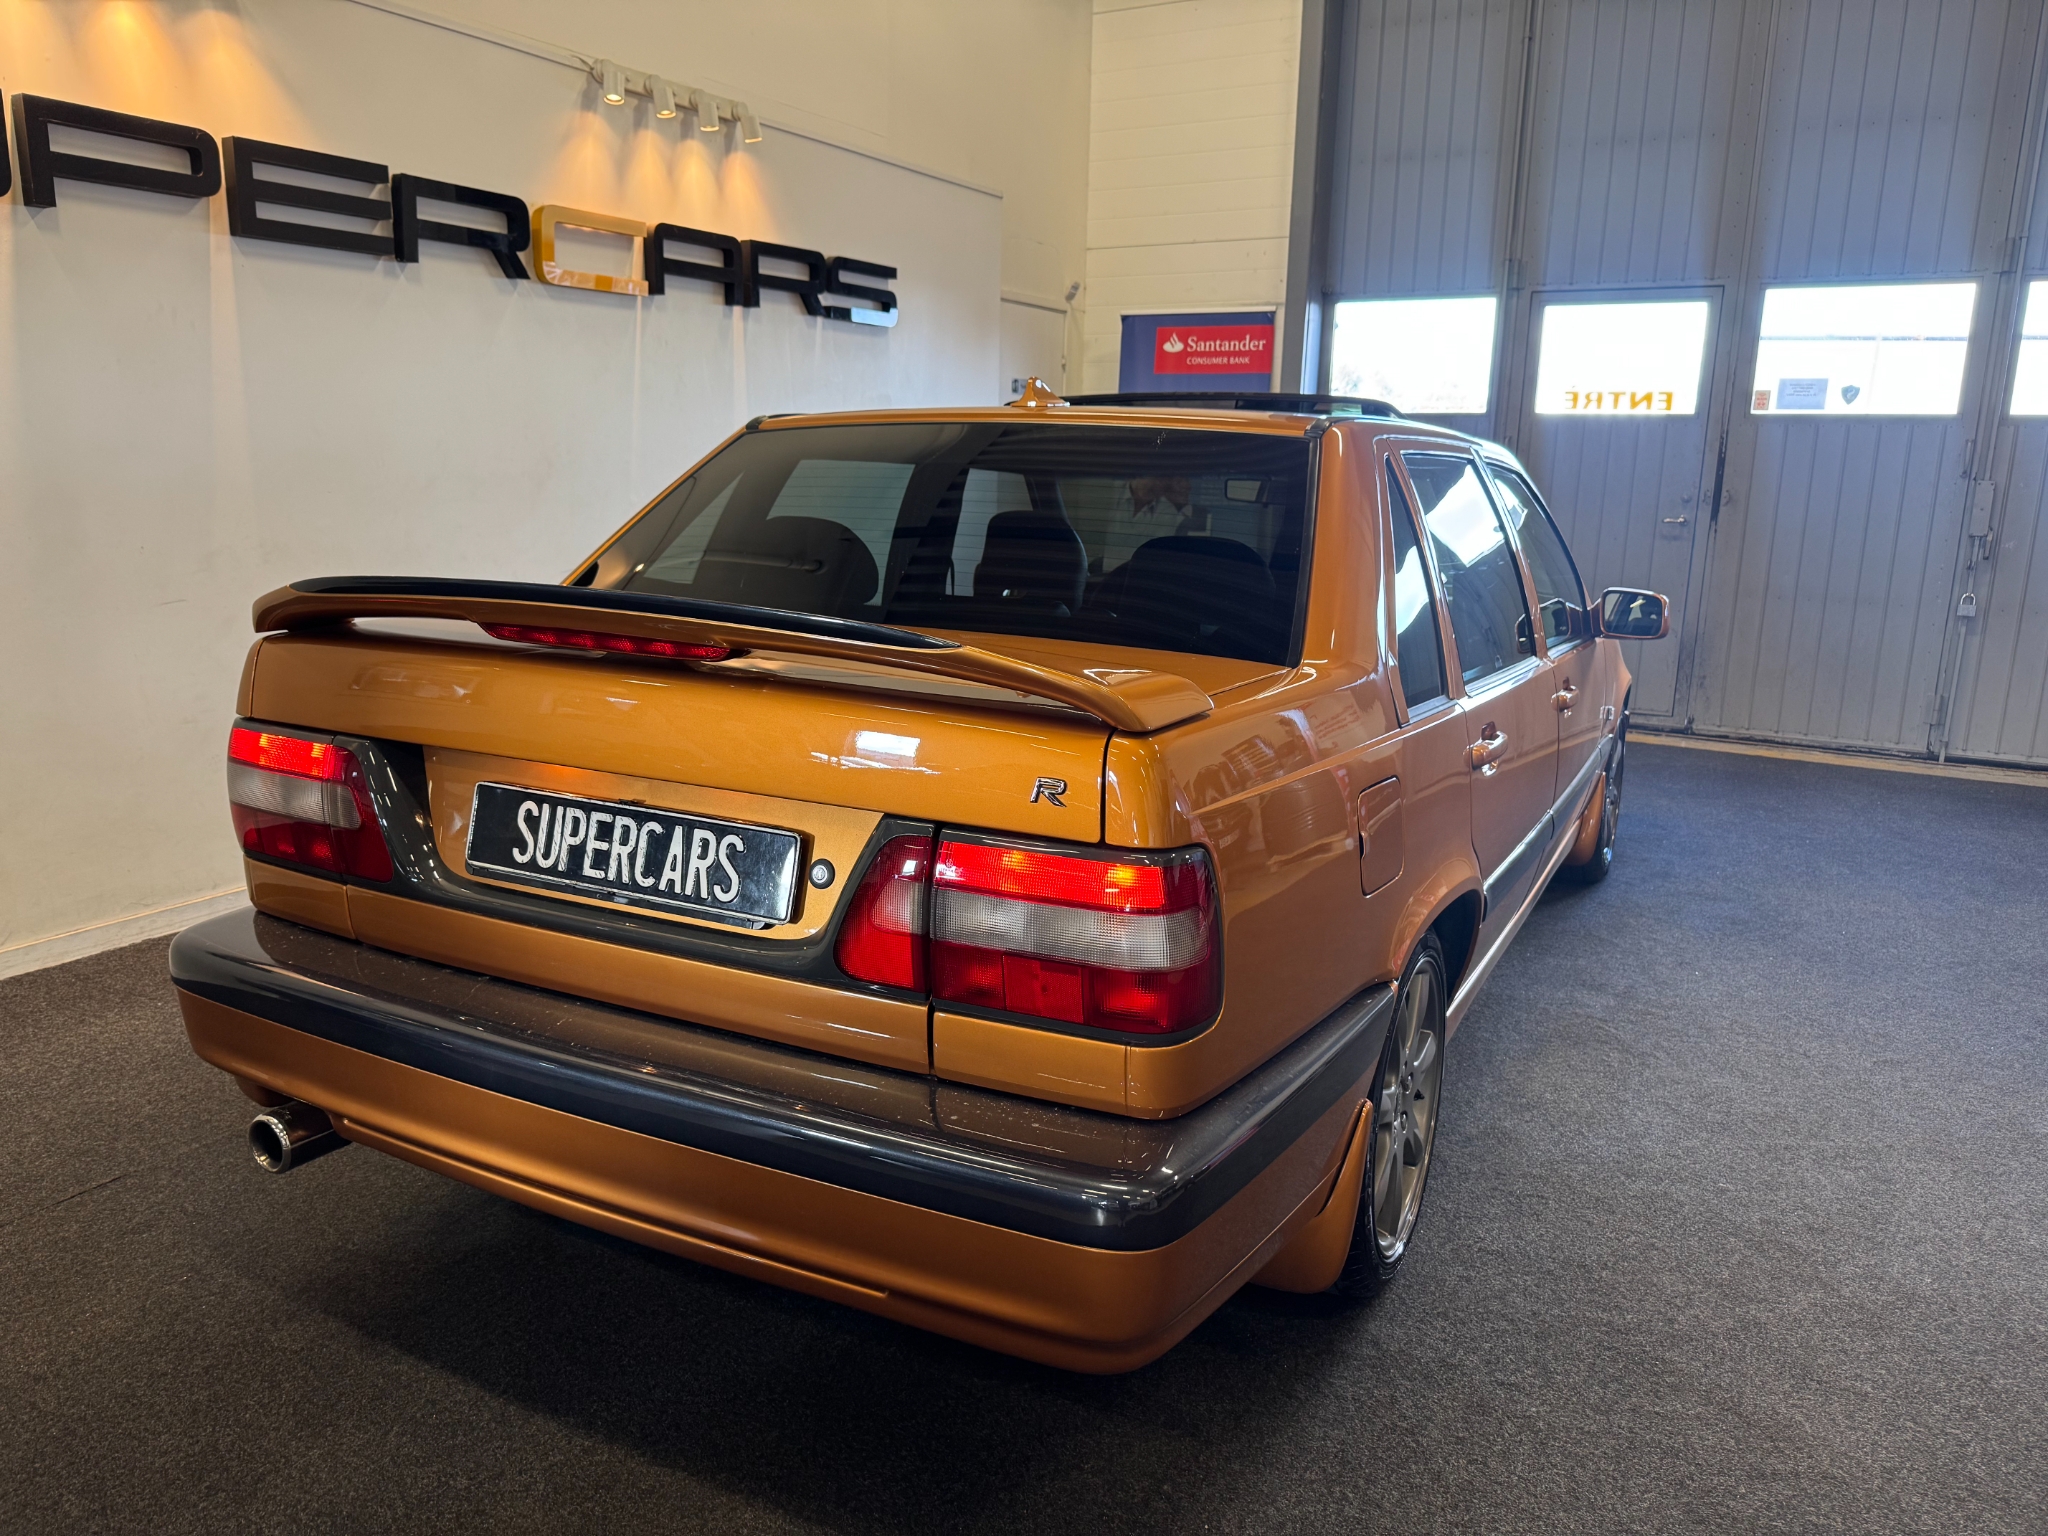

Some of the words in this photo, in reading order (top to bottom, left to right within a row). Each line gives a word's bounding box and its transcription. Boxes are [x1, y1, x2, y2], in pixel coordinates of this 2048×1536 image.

[0, 88, 898, 328] PERCARS
[1187, 334, 1266, 352] Santander
[1187, 356, 1228, 365] CONSUMER
[1229, 356, 1250, 365] BANK
[1029, 776, 1068, 808] R
[512, 800, 747, 903] SUPERCARS
